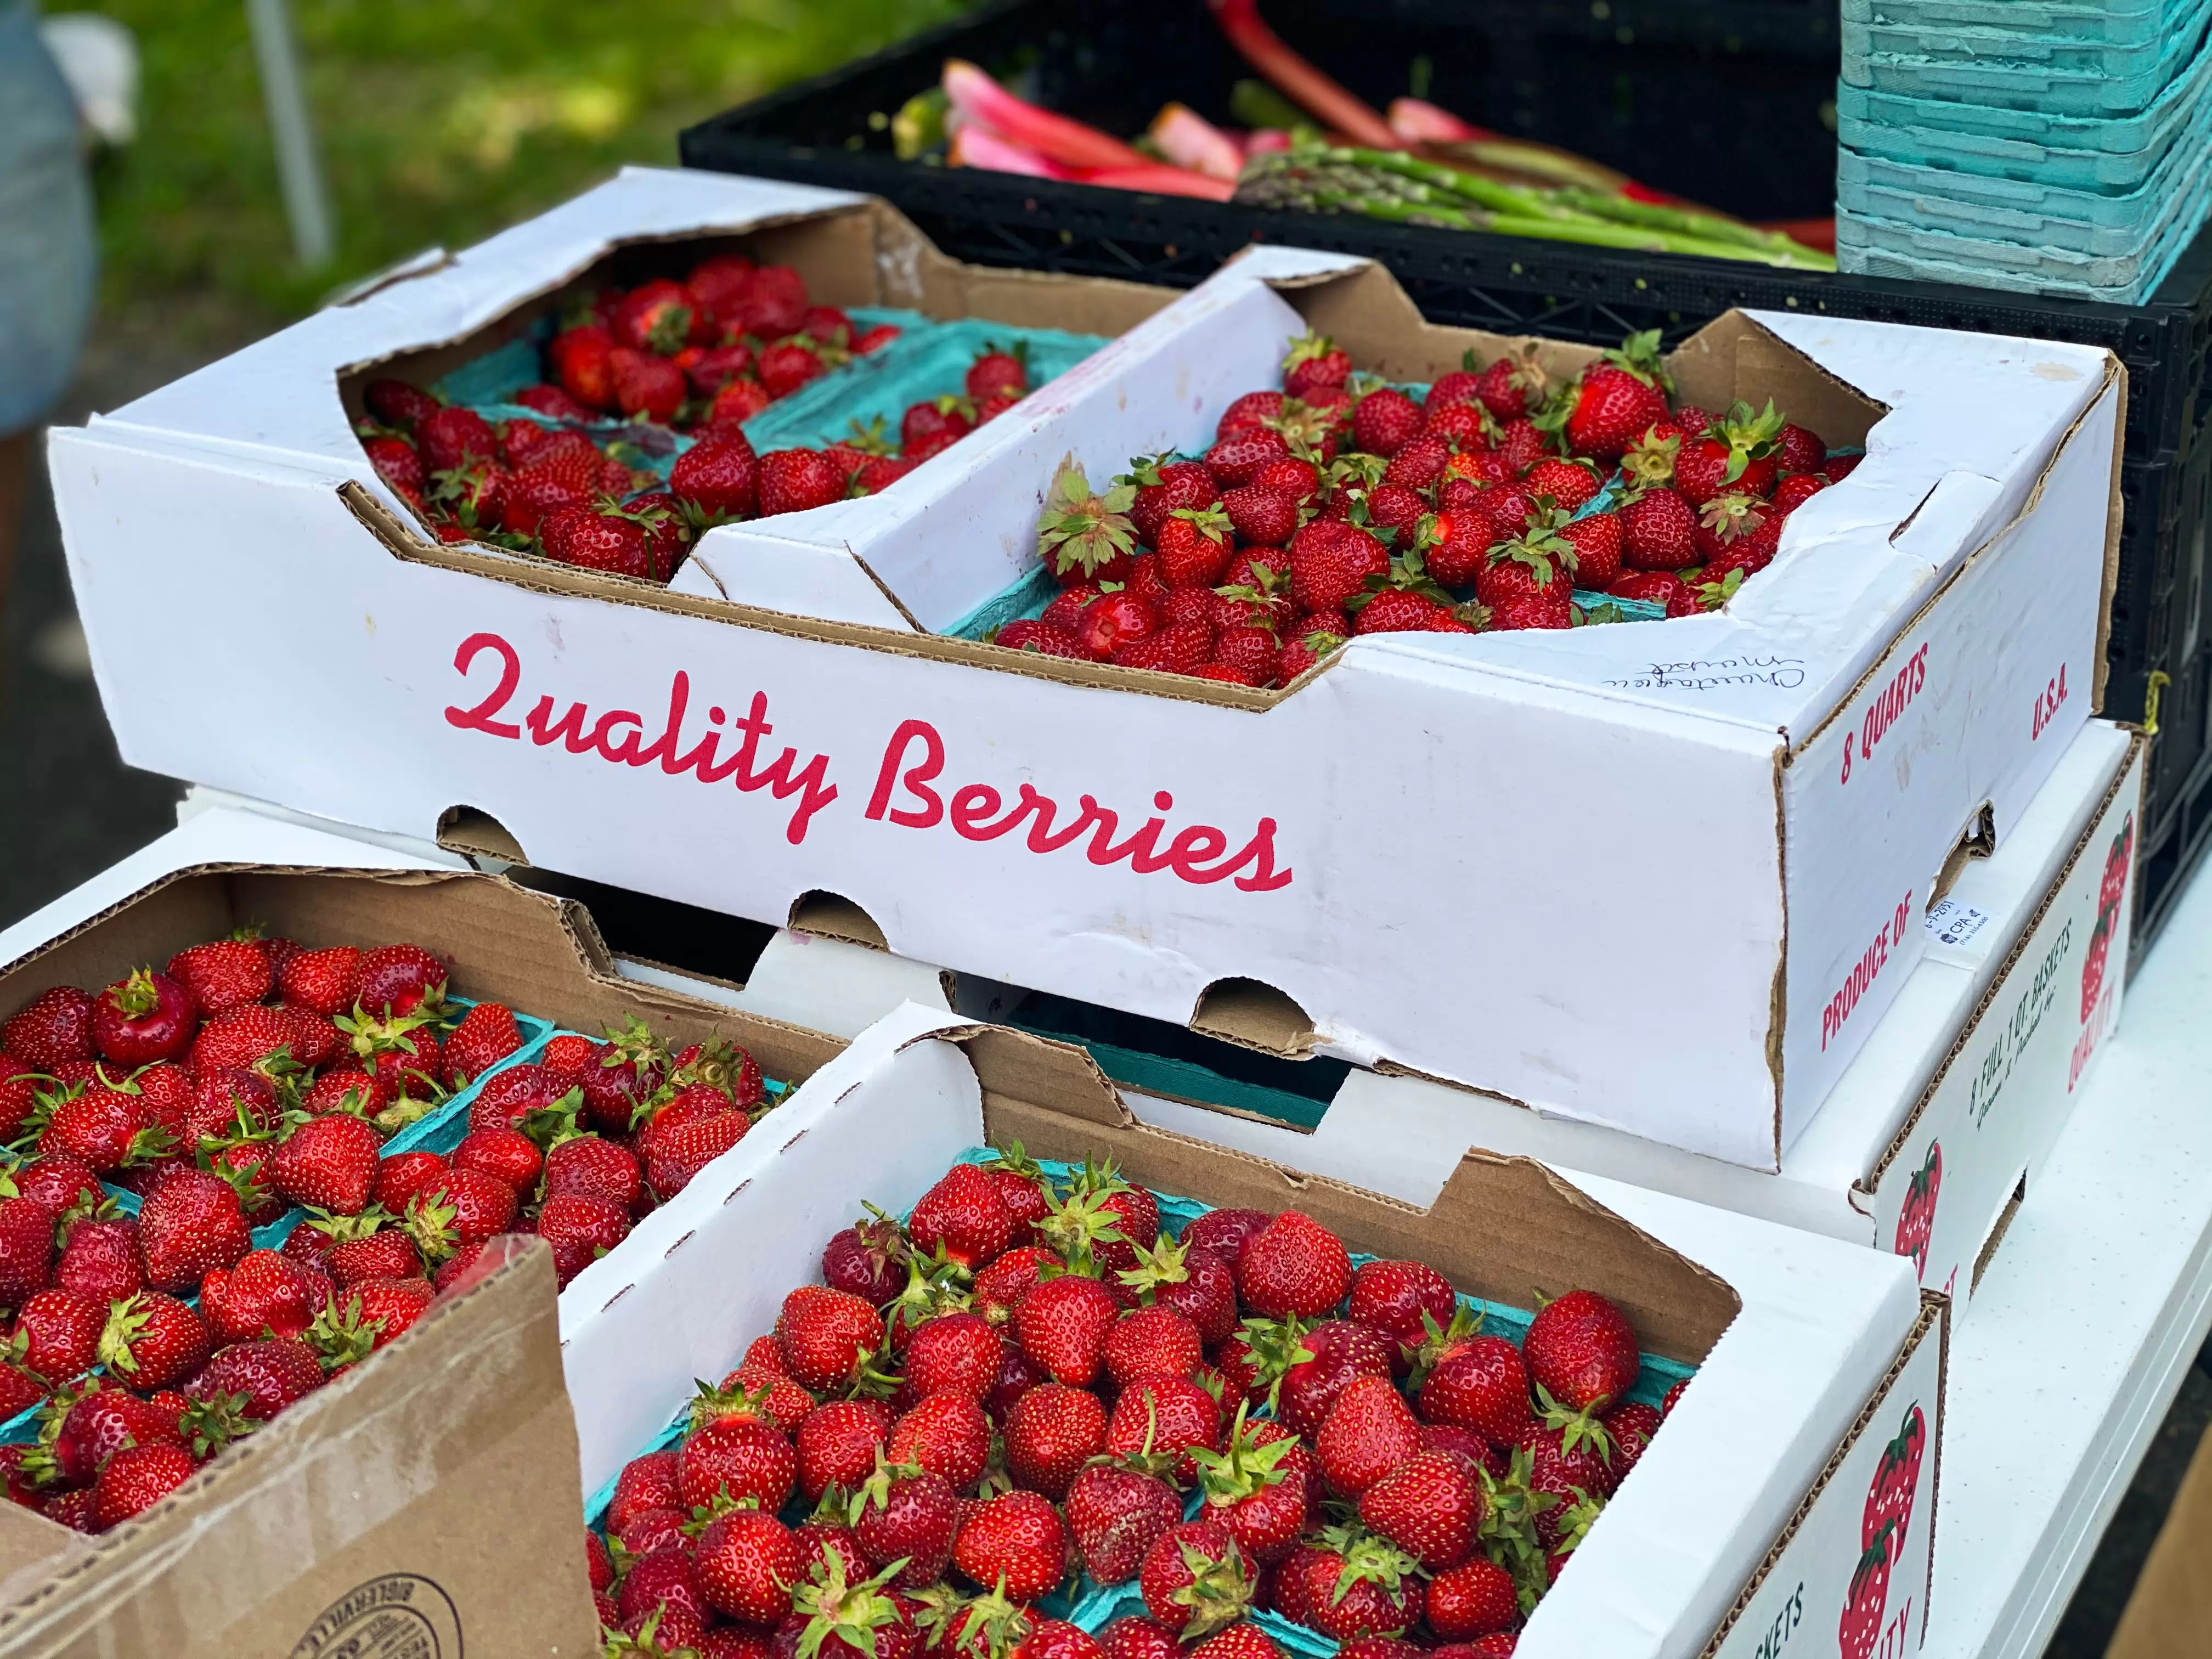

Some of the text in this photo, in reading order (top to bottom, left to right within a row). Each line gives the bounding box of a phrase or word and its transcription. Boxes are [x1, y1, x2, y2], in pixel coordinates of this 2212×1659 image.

[443, 632, 1293, 893] Quality Berries
[1841, 642, 1928, 785] 8 QUARTS
[1821, 662, 2067, 1053] PRODUCE OF U.S.A.
[1950, 918, 1973, 933] CPA
[1960, 934, 1973, 945] (716)
[1970, 1077, 1977, 1116] 8
[1980, 1032, 2002, 1099] FULL
[2007, 1015, 2013, 1052] 1
[2031, 917, 2072, 1012] BASKETS
[2015, 1000, 2043, 1065] Packed
